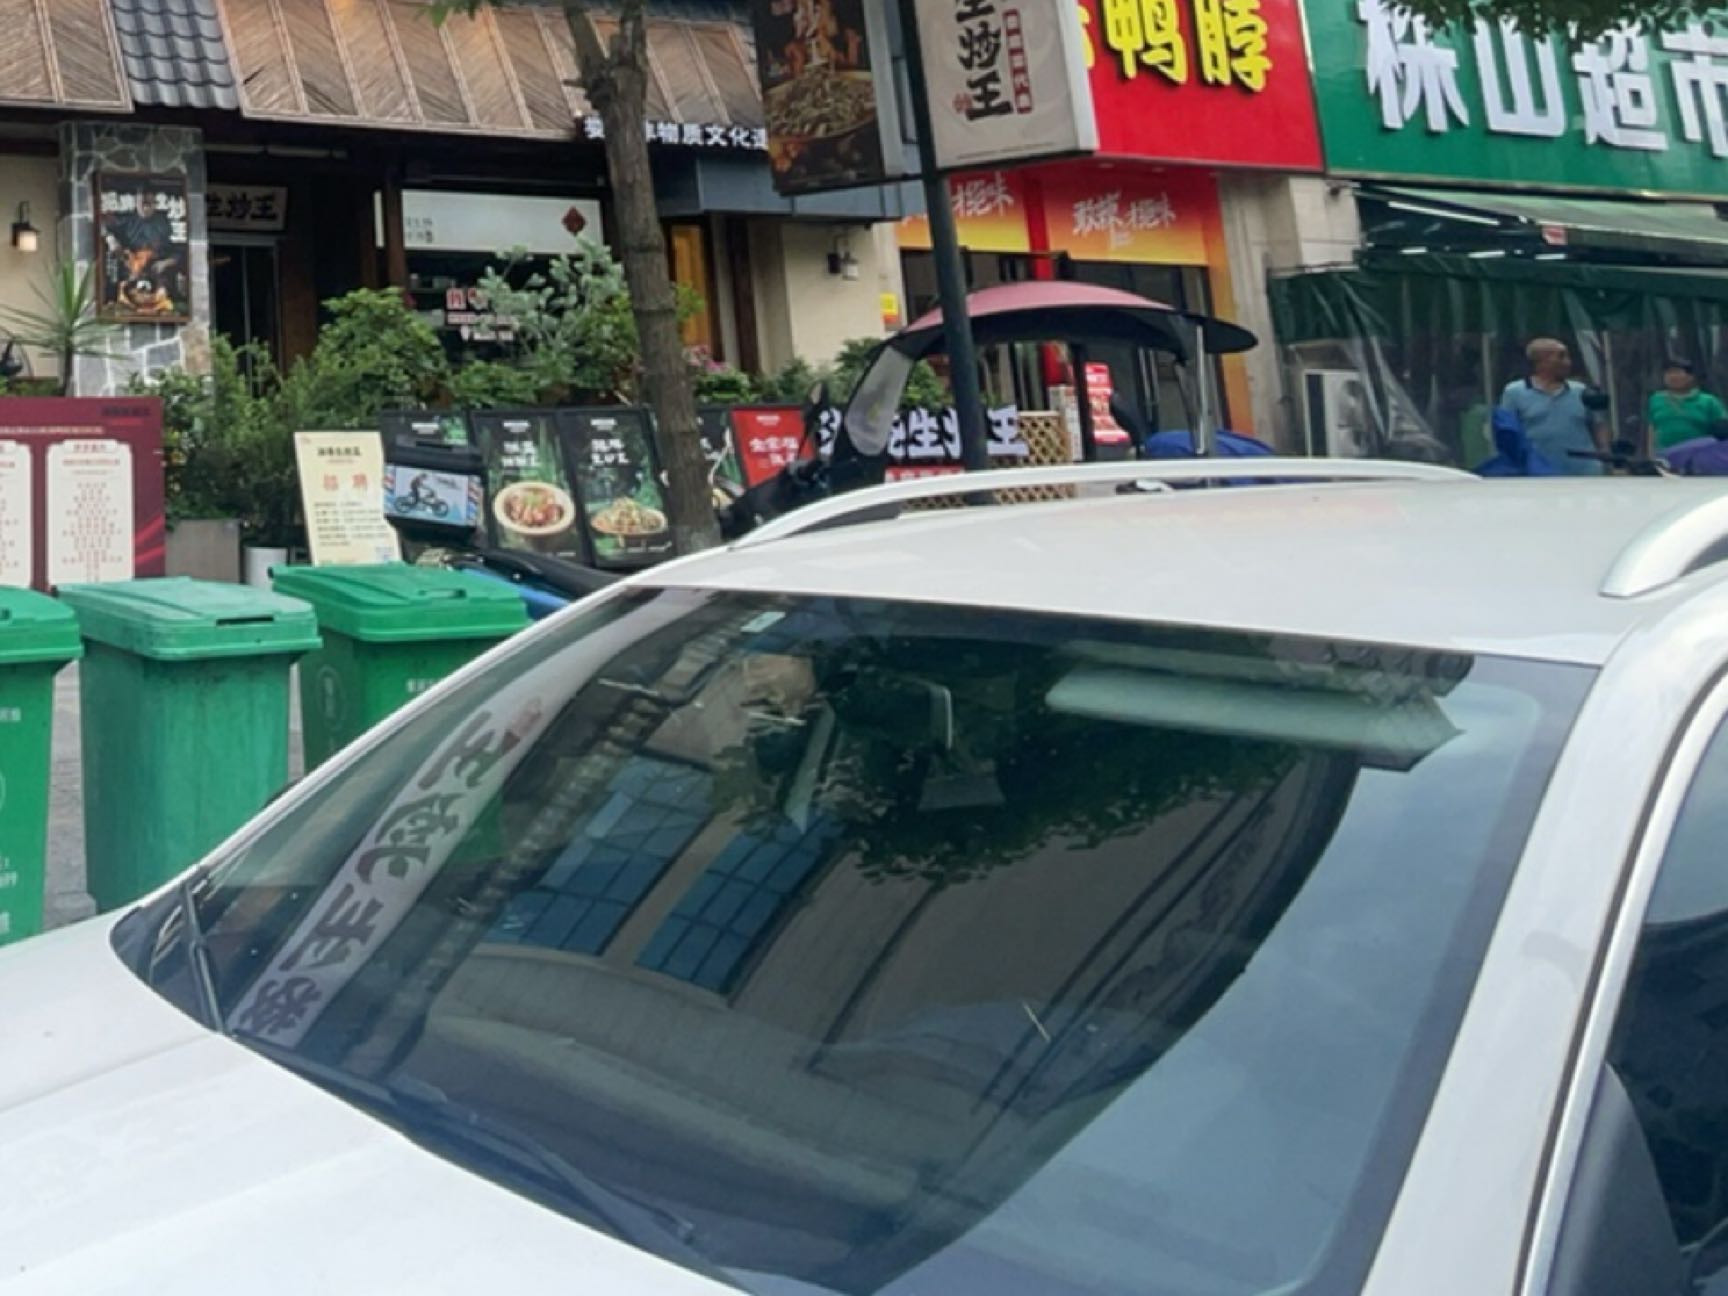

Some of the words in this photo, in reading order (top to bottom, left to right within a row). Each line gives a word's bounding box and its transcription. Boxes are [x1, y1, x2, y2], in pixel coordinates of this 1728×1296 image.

[583, 115, 769, 150] 娄物质文化遗
